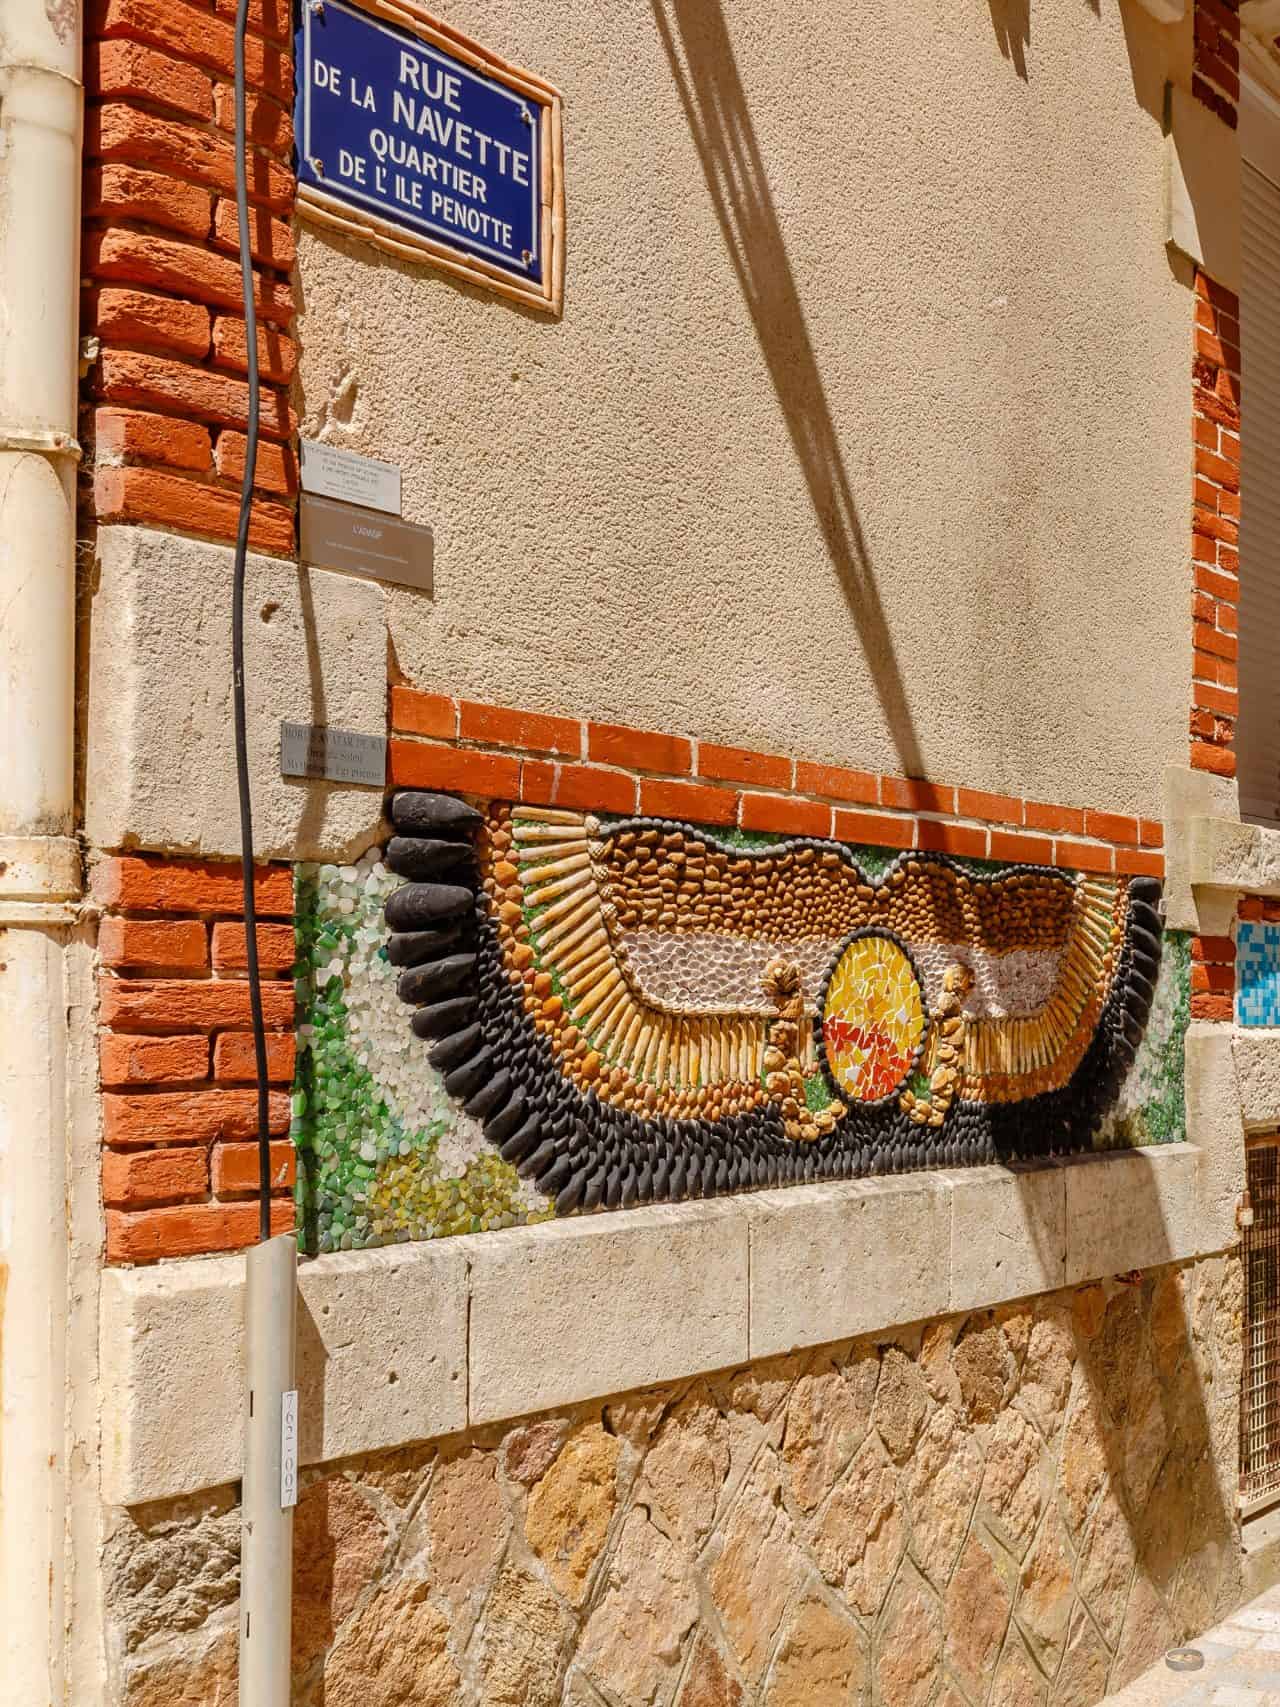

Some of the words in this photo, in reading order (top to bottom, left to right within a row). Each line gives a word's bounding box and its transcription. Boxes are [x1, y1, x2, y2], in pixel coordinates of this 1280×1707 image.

[313, 59, 342, 96] DE
[351, 77, 377, 113] LA
[393, 90, 529, 187] NAVETTE
[399, 50, 462, 112] RUE
[339, 149, 366, 185] DE
[431, 190, 513, 250] PENOTTE
[369, 128, 487, 204] QUARTIER
